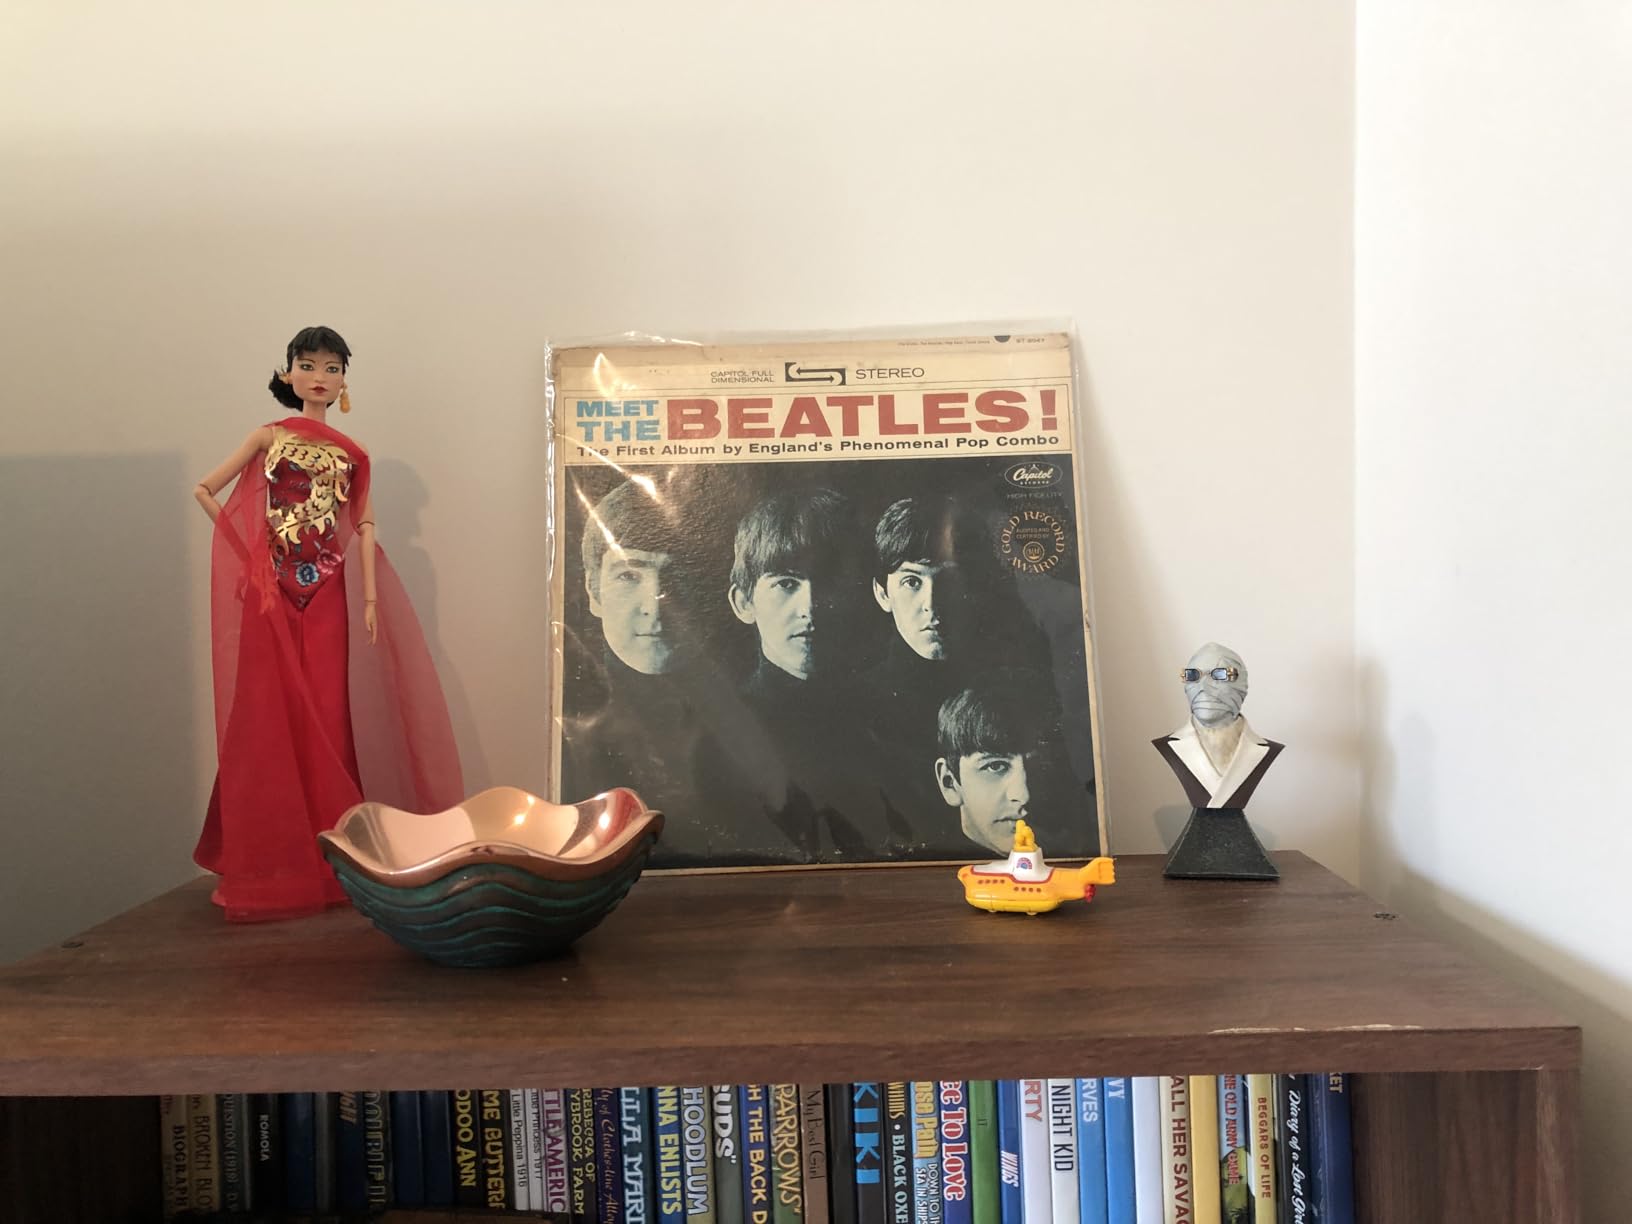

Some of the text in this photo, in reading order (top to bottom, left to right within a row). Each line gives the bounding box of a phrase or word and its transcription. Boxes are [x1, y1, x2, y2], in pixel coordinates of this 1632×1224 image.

[710, 369, 775, 378] CAPITOL FULL
[711, 376, 775, 384] DIMENSIONAL
[855, 367, 925, 380] STEREO
[576, 400, 659, 418] MEET
[667, 389, 1058, 441] BEATLES!
[576, 419, 661, 443] THE
[577, 434, 1059, 457] The First Album by England's Phenomenal Pop Combo
[1013, 467, 1054, 481] Capitol
[1000, 511, 1065, 554] GOLD RECORD
[1008, 554, 1059, 574] AWARD
[1024, 1080, 1043, 1122] RTY
[1081, 1078, 1098, 1123] RVES
[1224, 1091, 1238, 1116] OLD
[1286, 1090, 1302, 1134] Diary
[259, 1114, 271, 1162] ROMOLA
[511, 1094, 528, 1188] Little Peppina 1916
[582, 1089, 596, 1183] REBECCA OF
[748, 1106, 765, 1144] THE
[803, 1090, 825, 1180] My Best Girl
[853, 1083, 881, 1185] KIKI
[914, 1116, 939, 1159] Path
[976, 1118, 988, 1127] IT
[1051, 1085, 1075, 1172] NIGHT KID
[1172, 1118, 1187, 1158] HER
[1225, 1118, 1239, 1149] ARMY
[570, 1090, 585, 1215] YBROOK FARM
[683, 1086, 709, 1216] HOODLUM
[891, 1134, 907, 1188] BLACK
[1257, 1097, 1272, 1198] BEGGARS OF LIFE
[1288, 1136, 1301, 1151] of
[1291, 1152, 1299, 1161] a
[456, 1146, 476, 1188] ANN
[659, 1133, 683, 1215] ENLISTS
[749, 1149, 767, 1204] BACK
[916, 1167, 926, 1185] SEA
[928, 1163, 939, 1194] DOWN
[1000, 1149, 1019, 1188] WINGS
[1290, 1163, 1306, 1196] Lost
[917, 1187, 927, 1197] IN
[929, 1198, 940, 1213] TO
